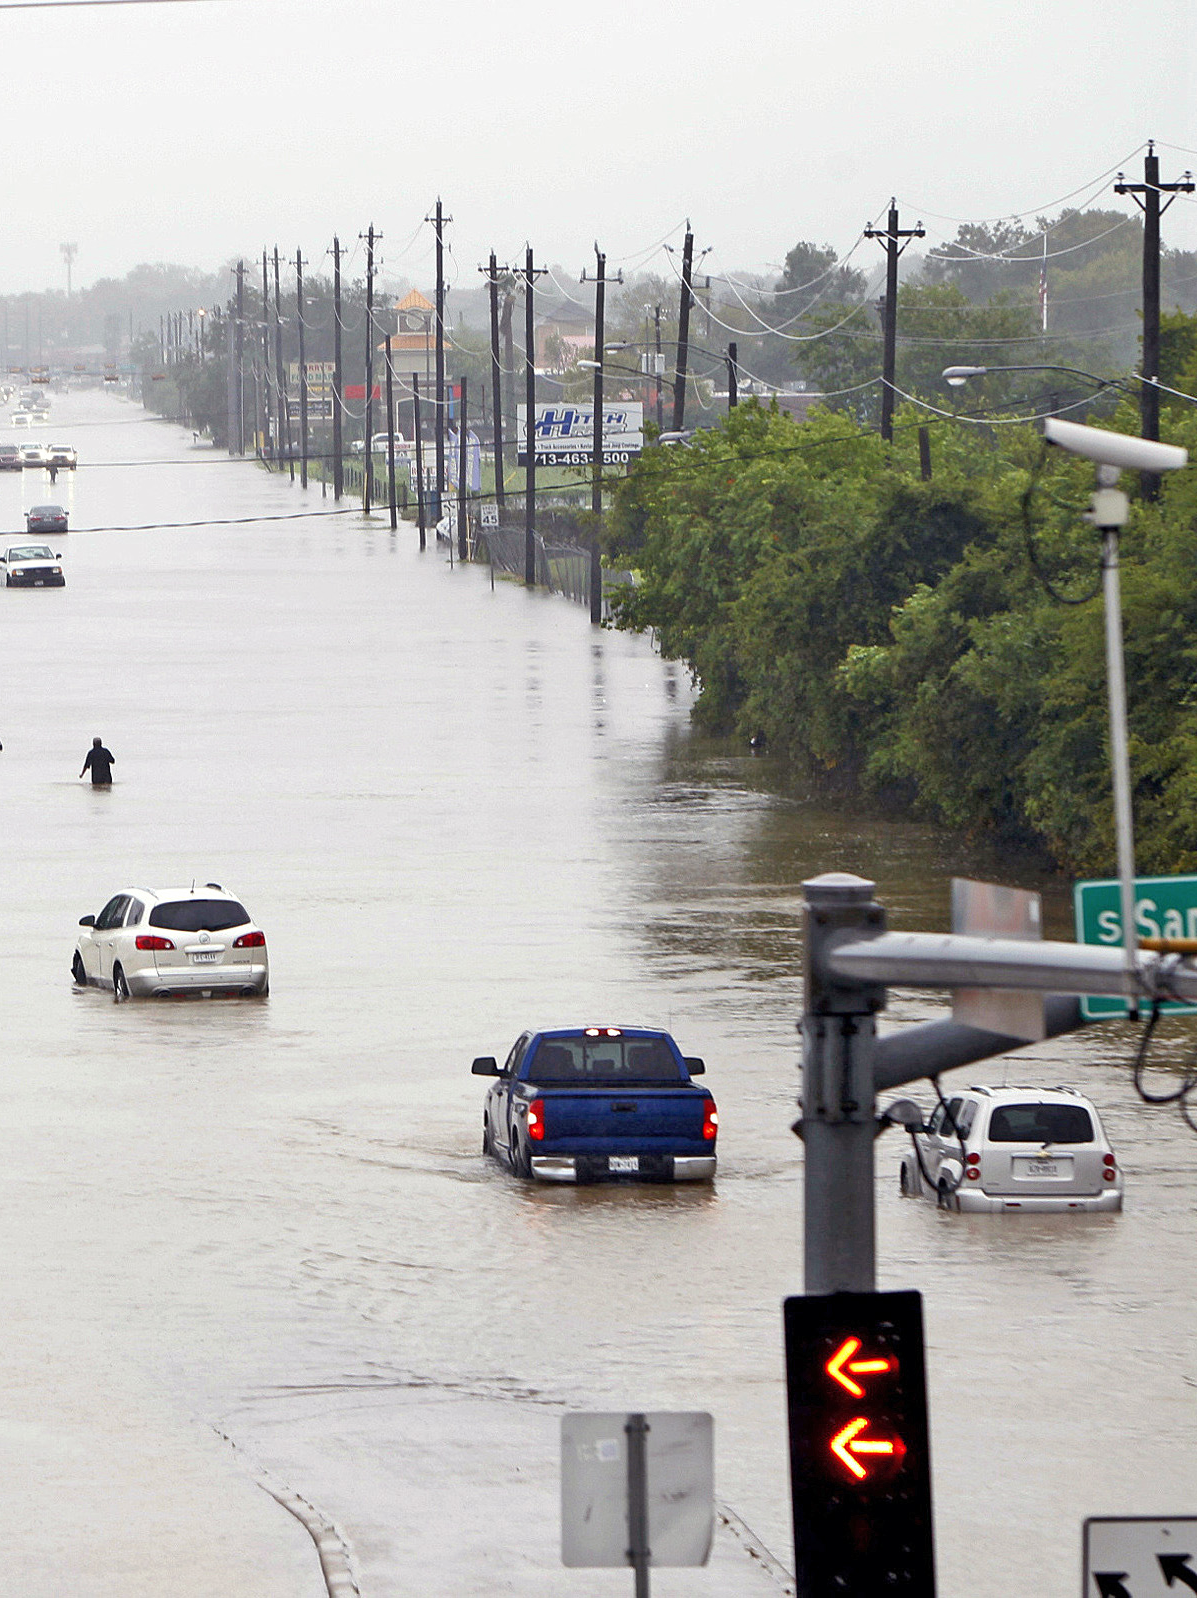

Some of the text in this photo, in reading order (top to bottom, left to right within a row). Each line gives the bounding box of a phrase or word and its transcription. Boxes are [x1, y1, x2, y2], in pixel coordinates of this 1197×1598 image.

[534, 452, 629, 465] 713-463-500
[482, 515, 498, 524] 45
[1097, 910, 1122, 943] S
